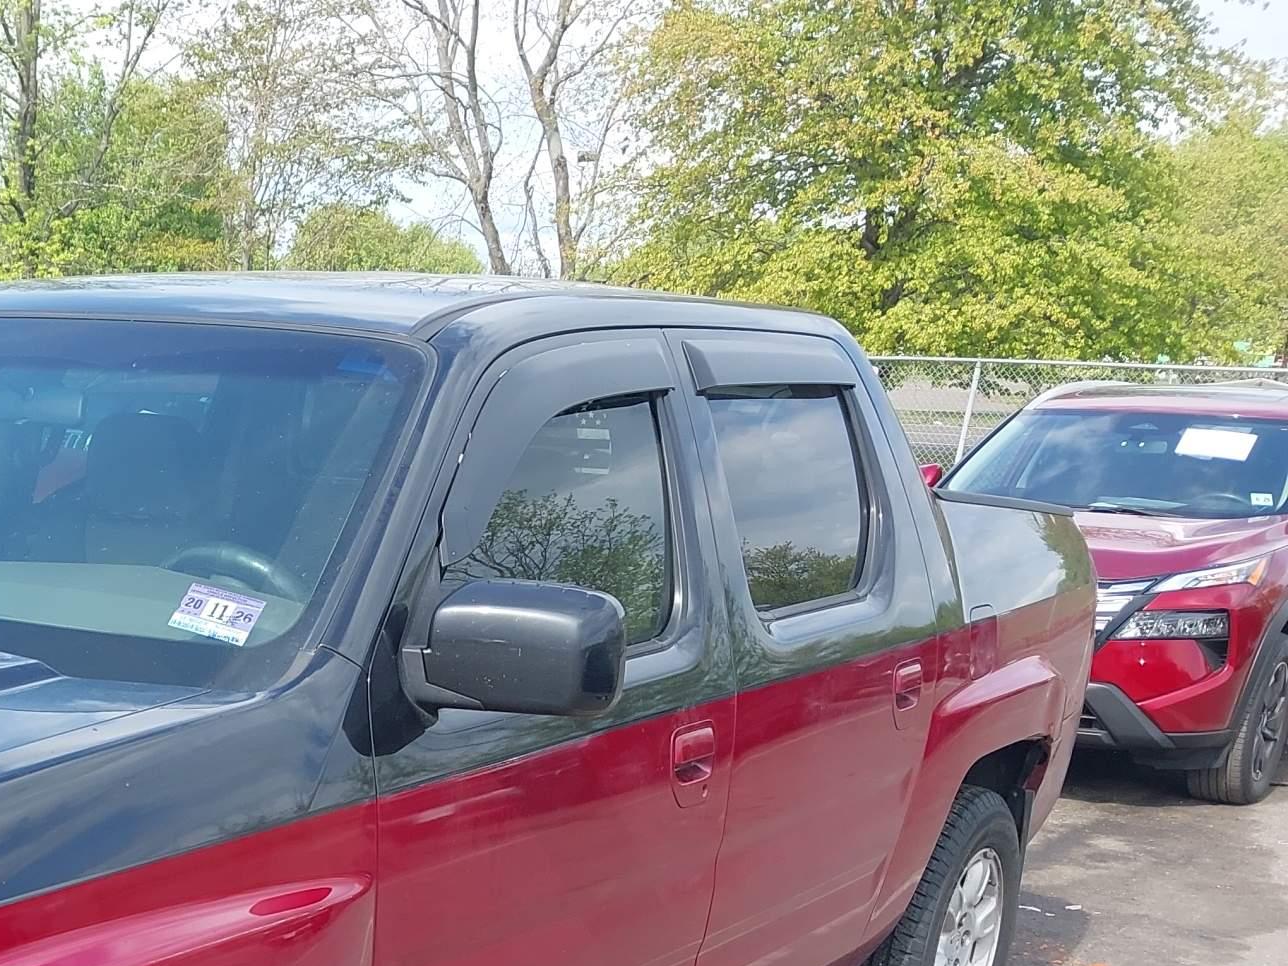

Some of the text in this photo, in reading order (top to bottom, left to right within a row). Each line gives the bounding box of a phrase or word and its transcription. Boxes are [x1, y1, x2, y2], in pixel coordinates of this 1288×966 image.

[185, 597, 254, 624] 20 11 26
